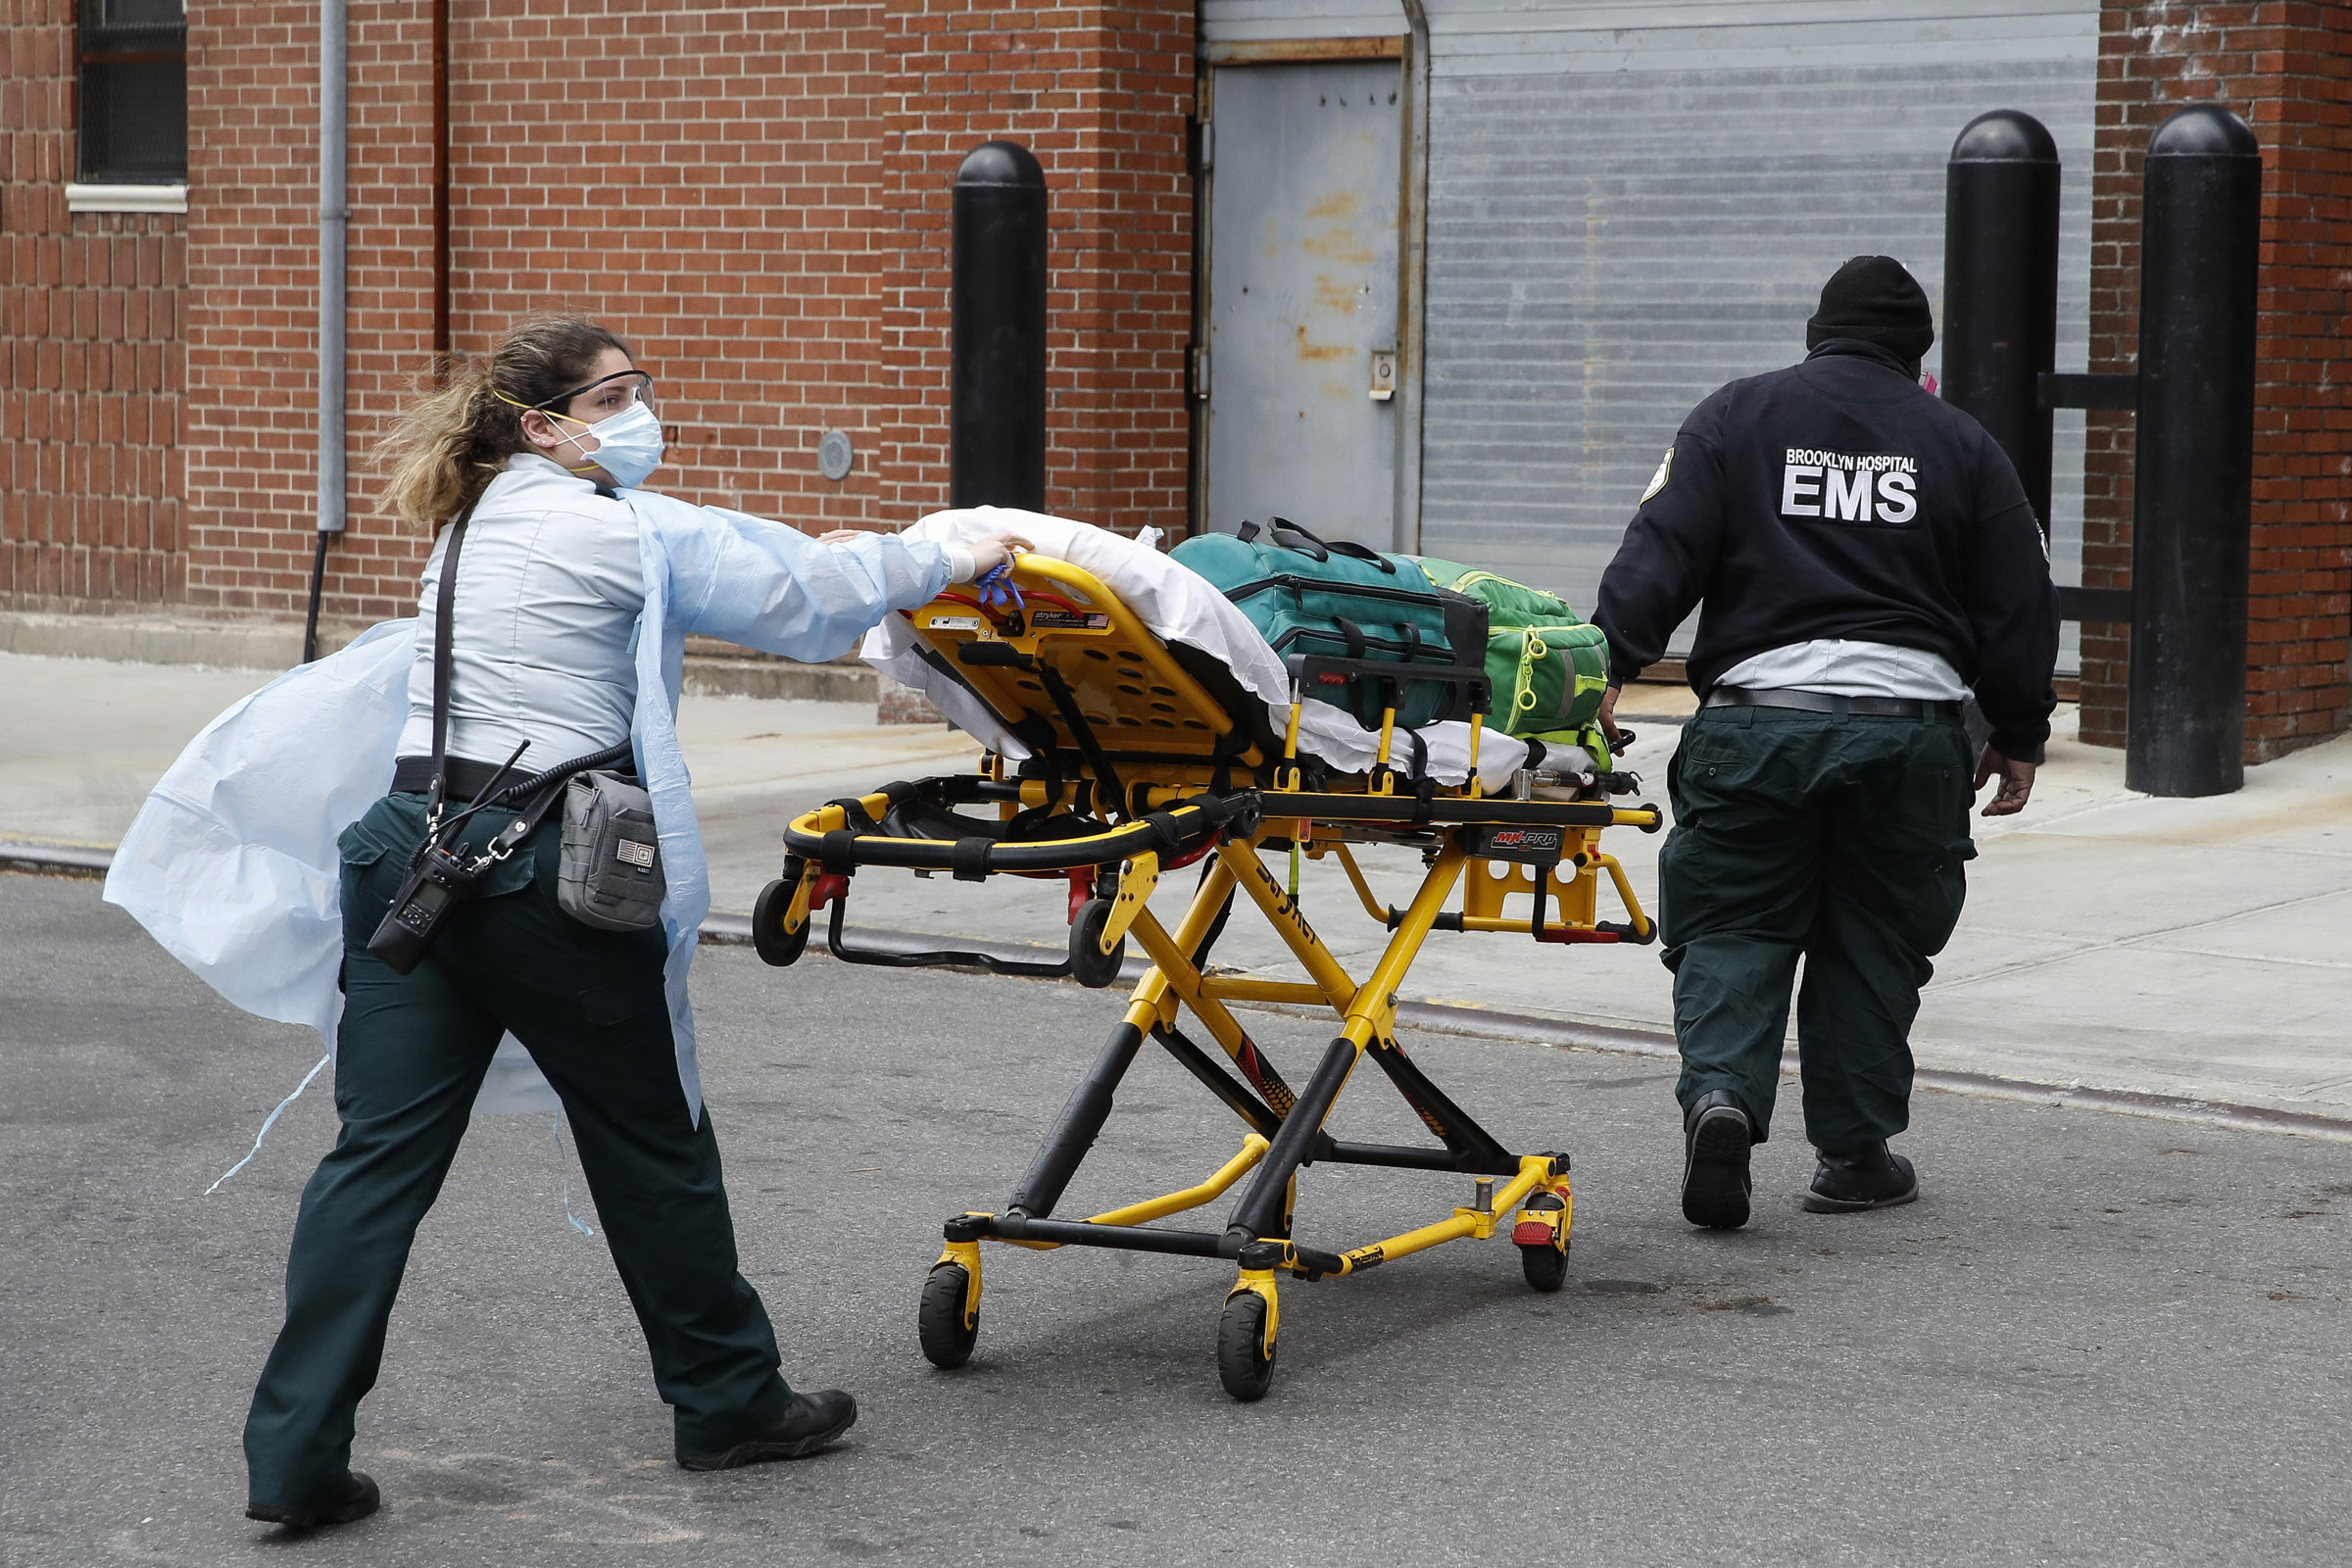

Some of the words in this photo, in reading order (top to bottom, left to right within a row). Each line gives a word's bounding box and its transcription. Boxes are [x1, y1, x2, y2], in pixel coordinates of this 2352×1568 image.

[1786, 448, 1853, 471] BROOKLYN
[1856, 456, 1918, 473] HOSPITAL
[1781, 464, 1917, 523] EMS
[1494, 830, 1557, 846] MX-PRO
